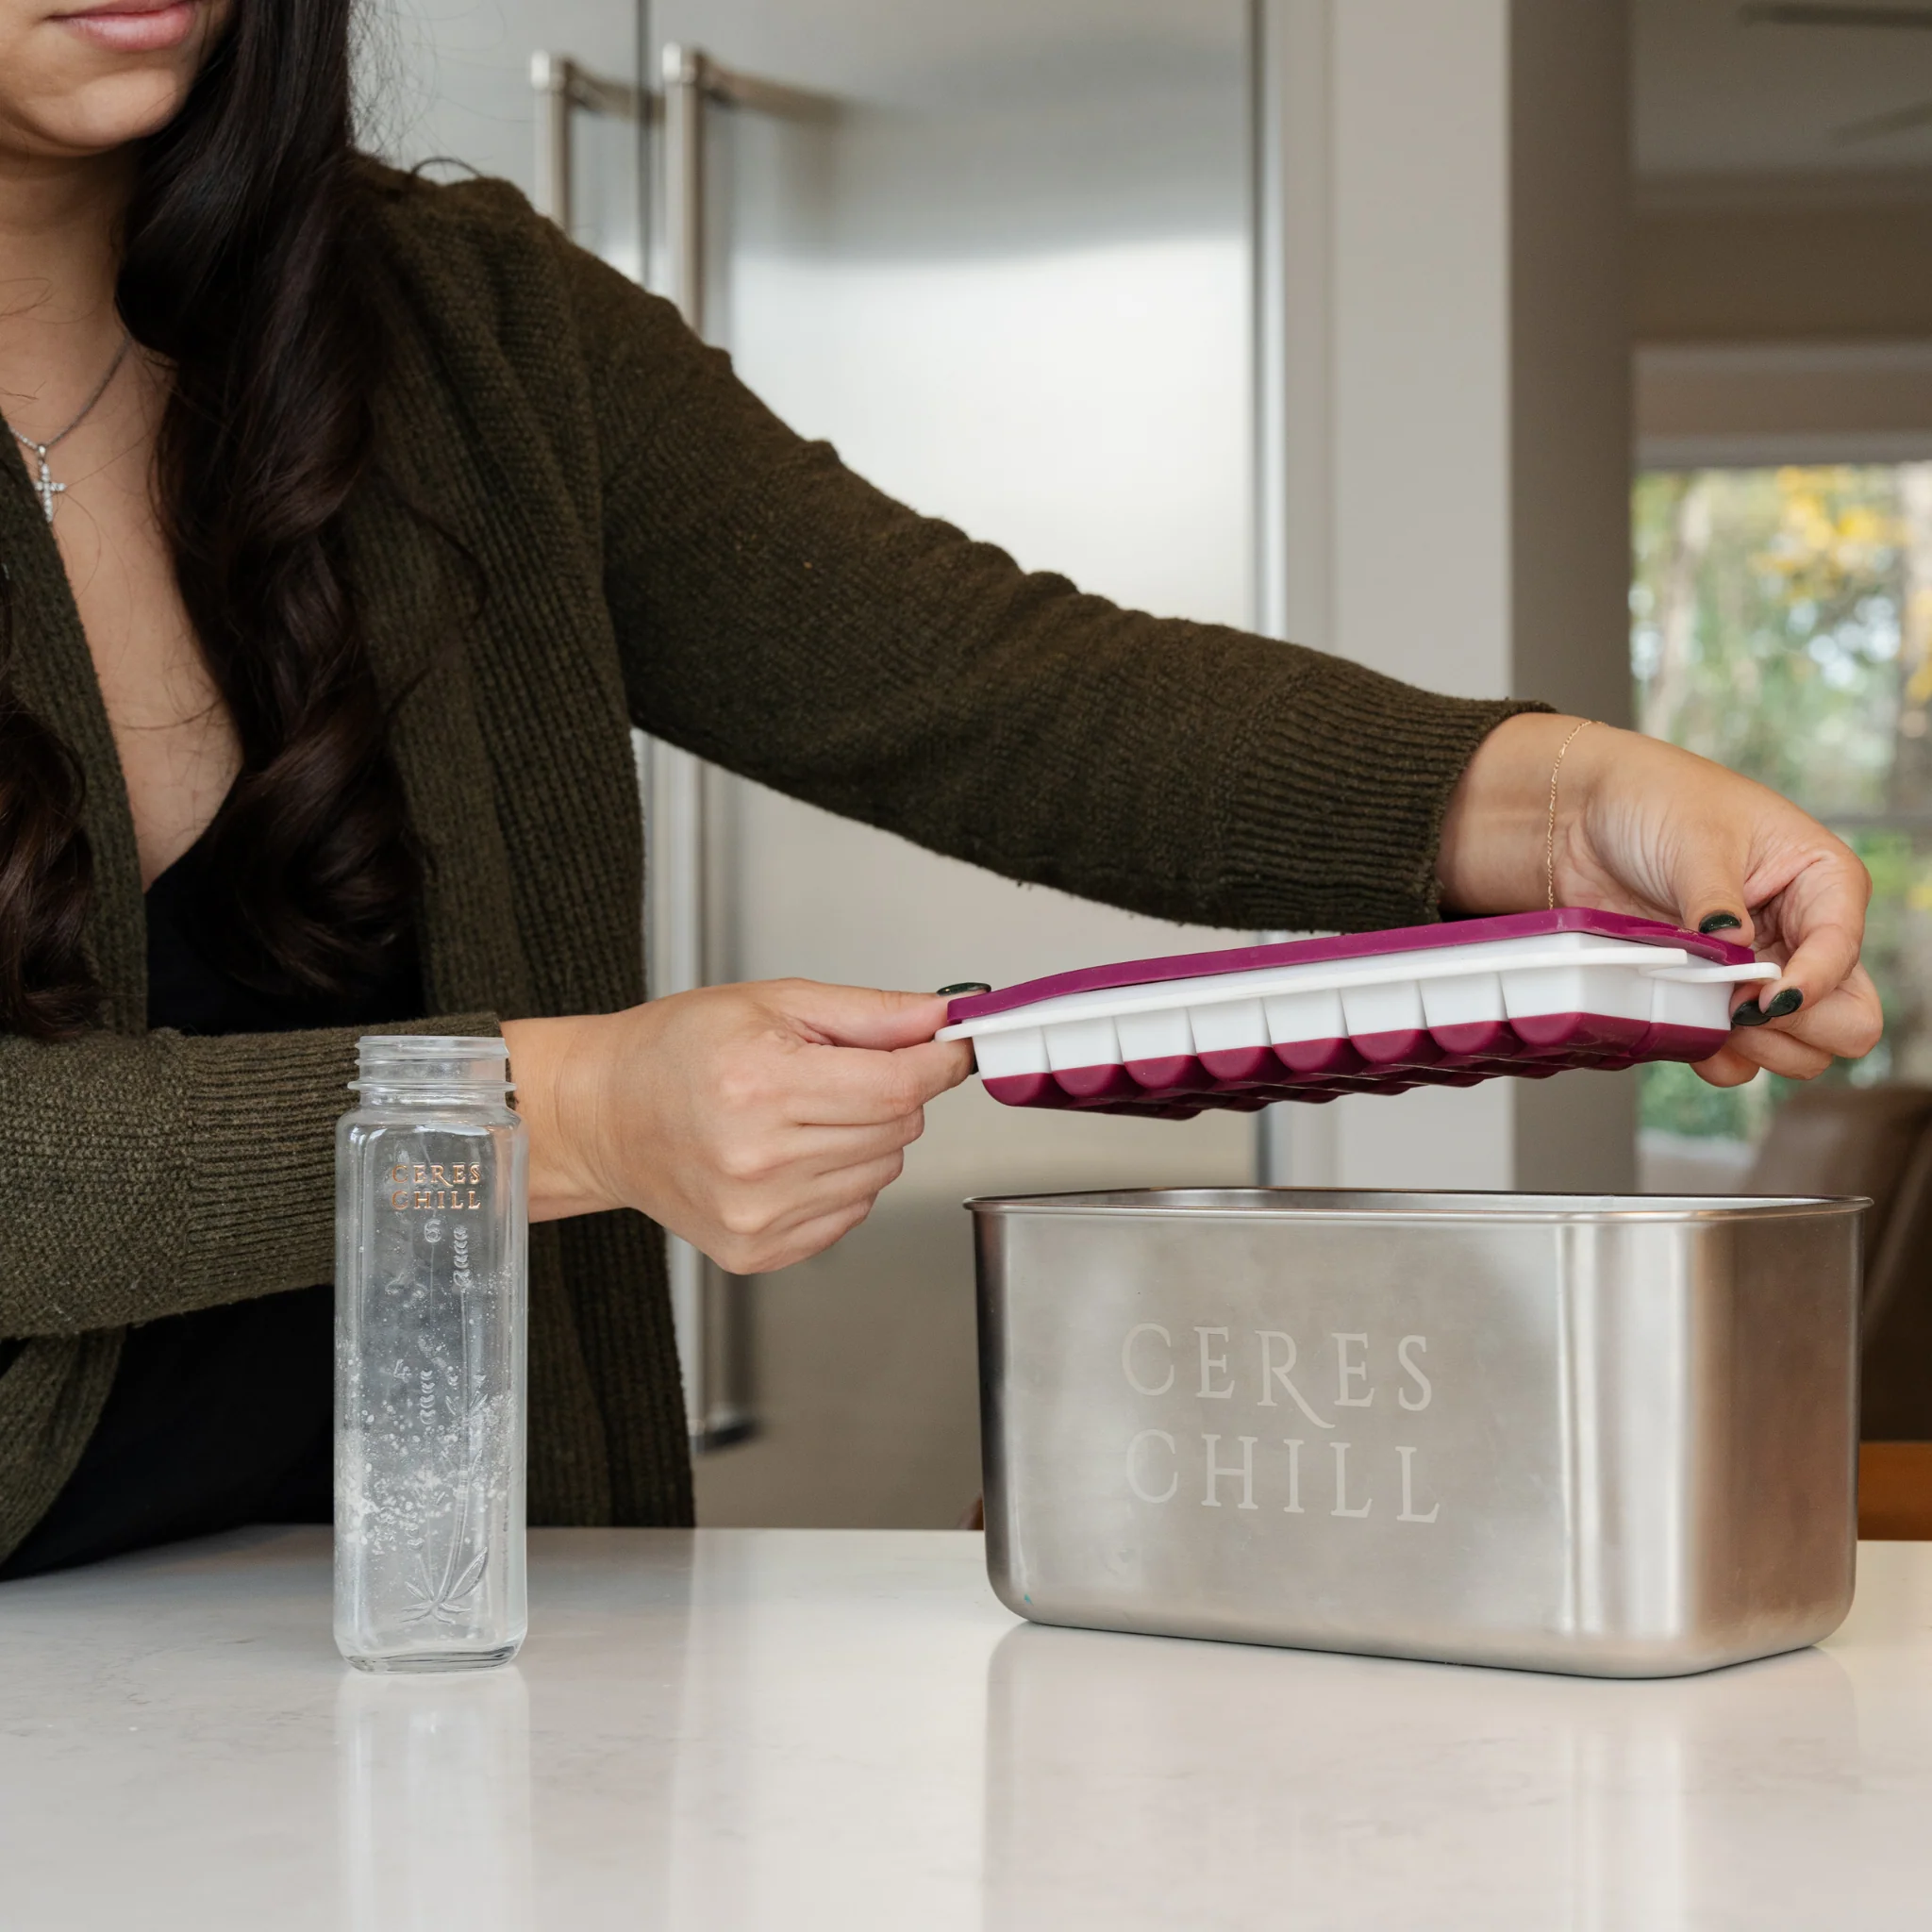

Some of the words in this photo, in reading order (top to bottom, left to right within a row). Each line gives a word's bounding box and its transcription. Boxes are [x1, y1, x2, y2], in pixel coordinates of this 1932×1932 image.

[391, 1163, 481, 1188] CERES
[391, 1190, 481, 1209] CHILL
[424, 1218, 442, 1243] 6
[1121, 1322, 1432, 1428] CERES
[1125, 1428, 1441, 1524] CHILL
